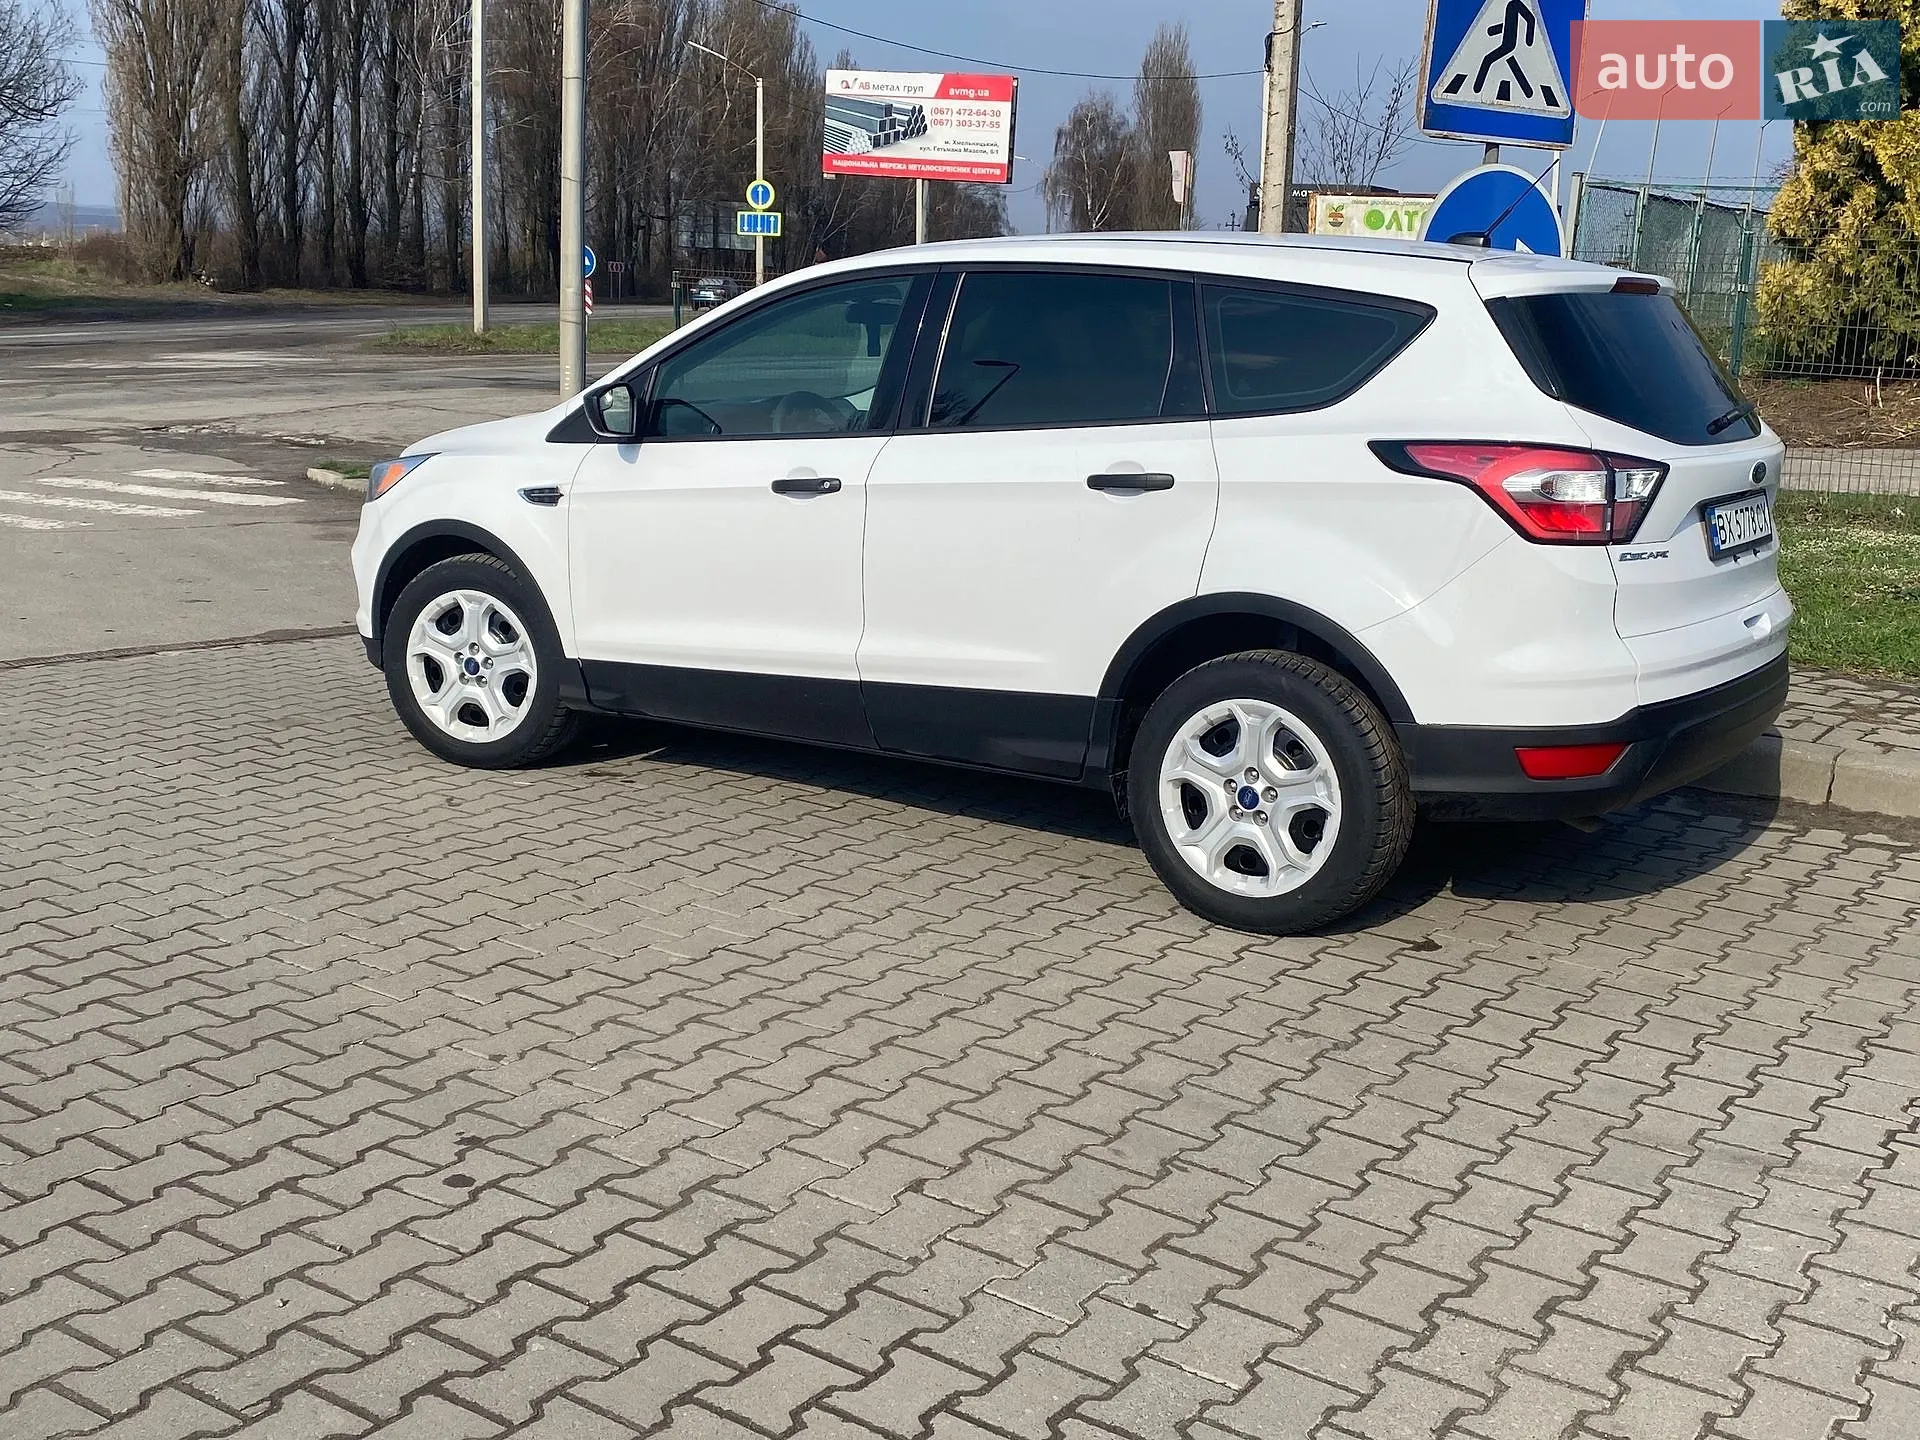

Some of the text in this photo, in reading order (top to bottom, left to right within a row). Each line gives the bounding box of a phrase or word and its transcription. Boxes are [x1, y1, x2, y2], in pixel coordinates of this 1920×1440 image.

[872, 83, 900, 92] метал
[903, 85, 924, 95] груп
[949, 87, 990, 98] avmg.ua
[930, 107, 1001, 117] (067) 472-64-30
[930, 118, 1001, 128] (067) 303-37-55
[832, 159, 879, 169] НАЦІОНАЛЬНА
[879, 161, 907, 171] МЕРЕЖА
[972, 167, 1001, 176] ЦЕНТРІВ
[1363, 208, 1429, 232] ОЛТ
[1619, 550, 1669, 561] ESCAPE
